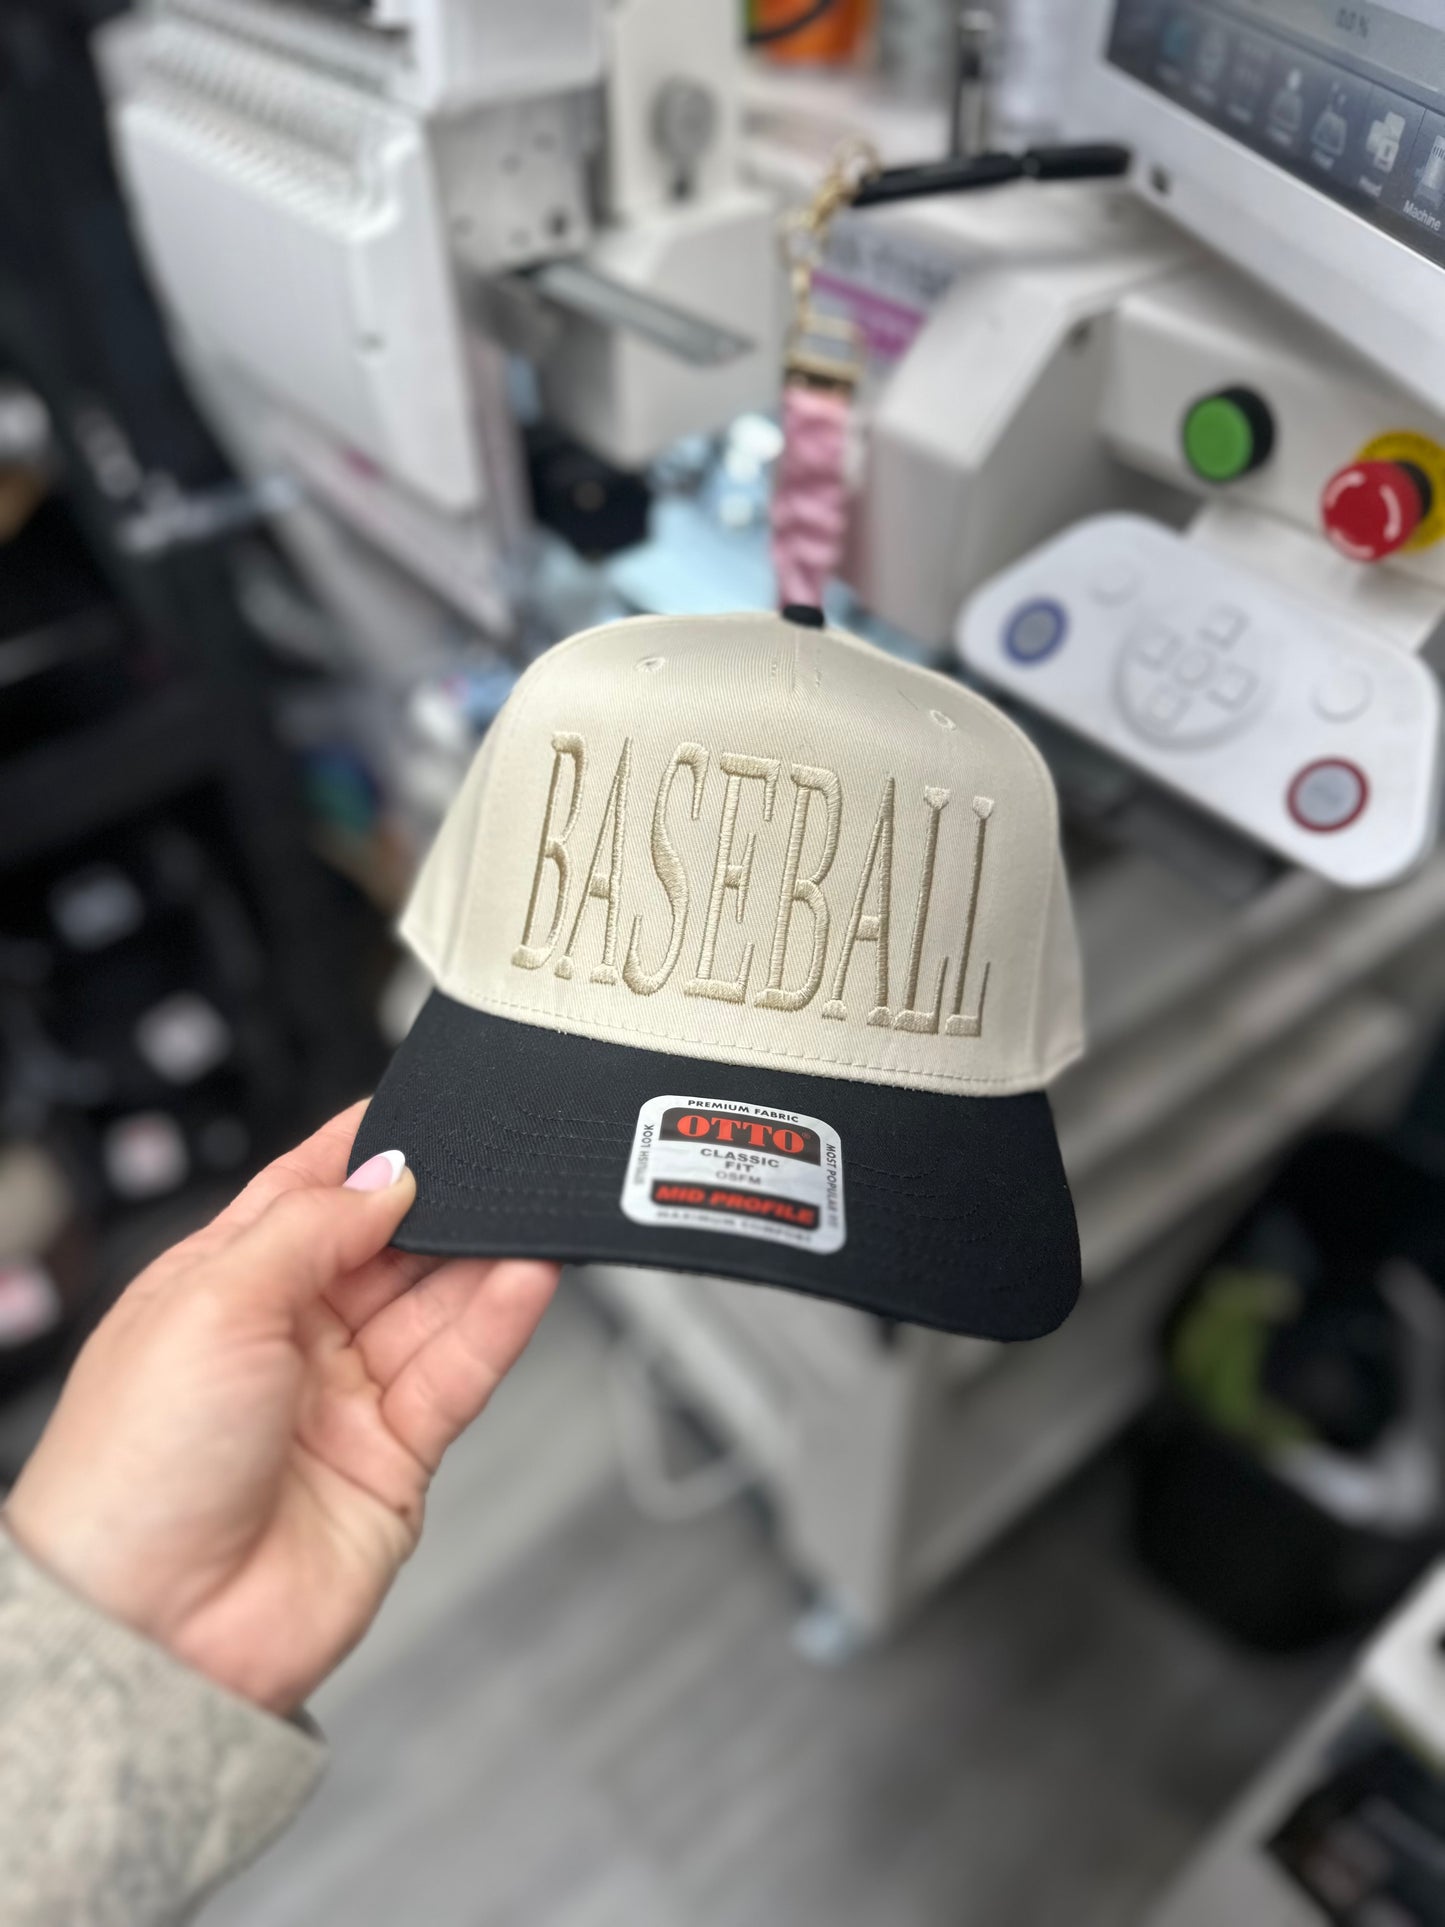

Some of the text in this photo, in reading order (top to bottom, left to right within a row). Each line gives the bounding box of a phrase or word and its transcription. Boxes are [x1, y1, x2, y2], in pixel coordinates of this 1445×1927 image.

[1402, 200, 1441, 231] Machine
[511, 731, 995, 1037] BASEBALL
[688, 1099, 799, 1123] PREMIUM FABRIC
[640, 1123, 655, 1148] LOOK
[676, 1114, 805, 1154] OTTO
[700, 1147, 780, 1169] CLASSIC
[725, 1161, 754, 1173] FIT
[825, 1143, 837, 1168] MOST
[715, 1170, 762, 1185] OSFM
[655, 1184, 815, 1226] MID PROFILE
